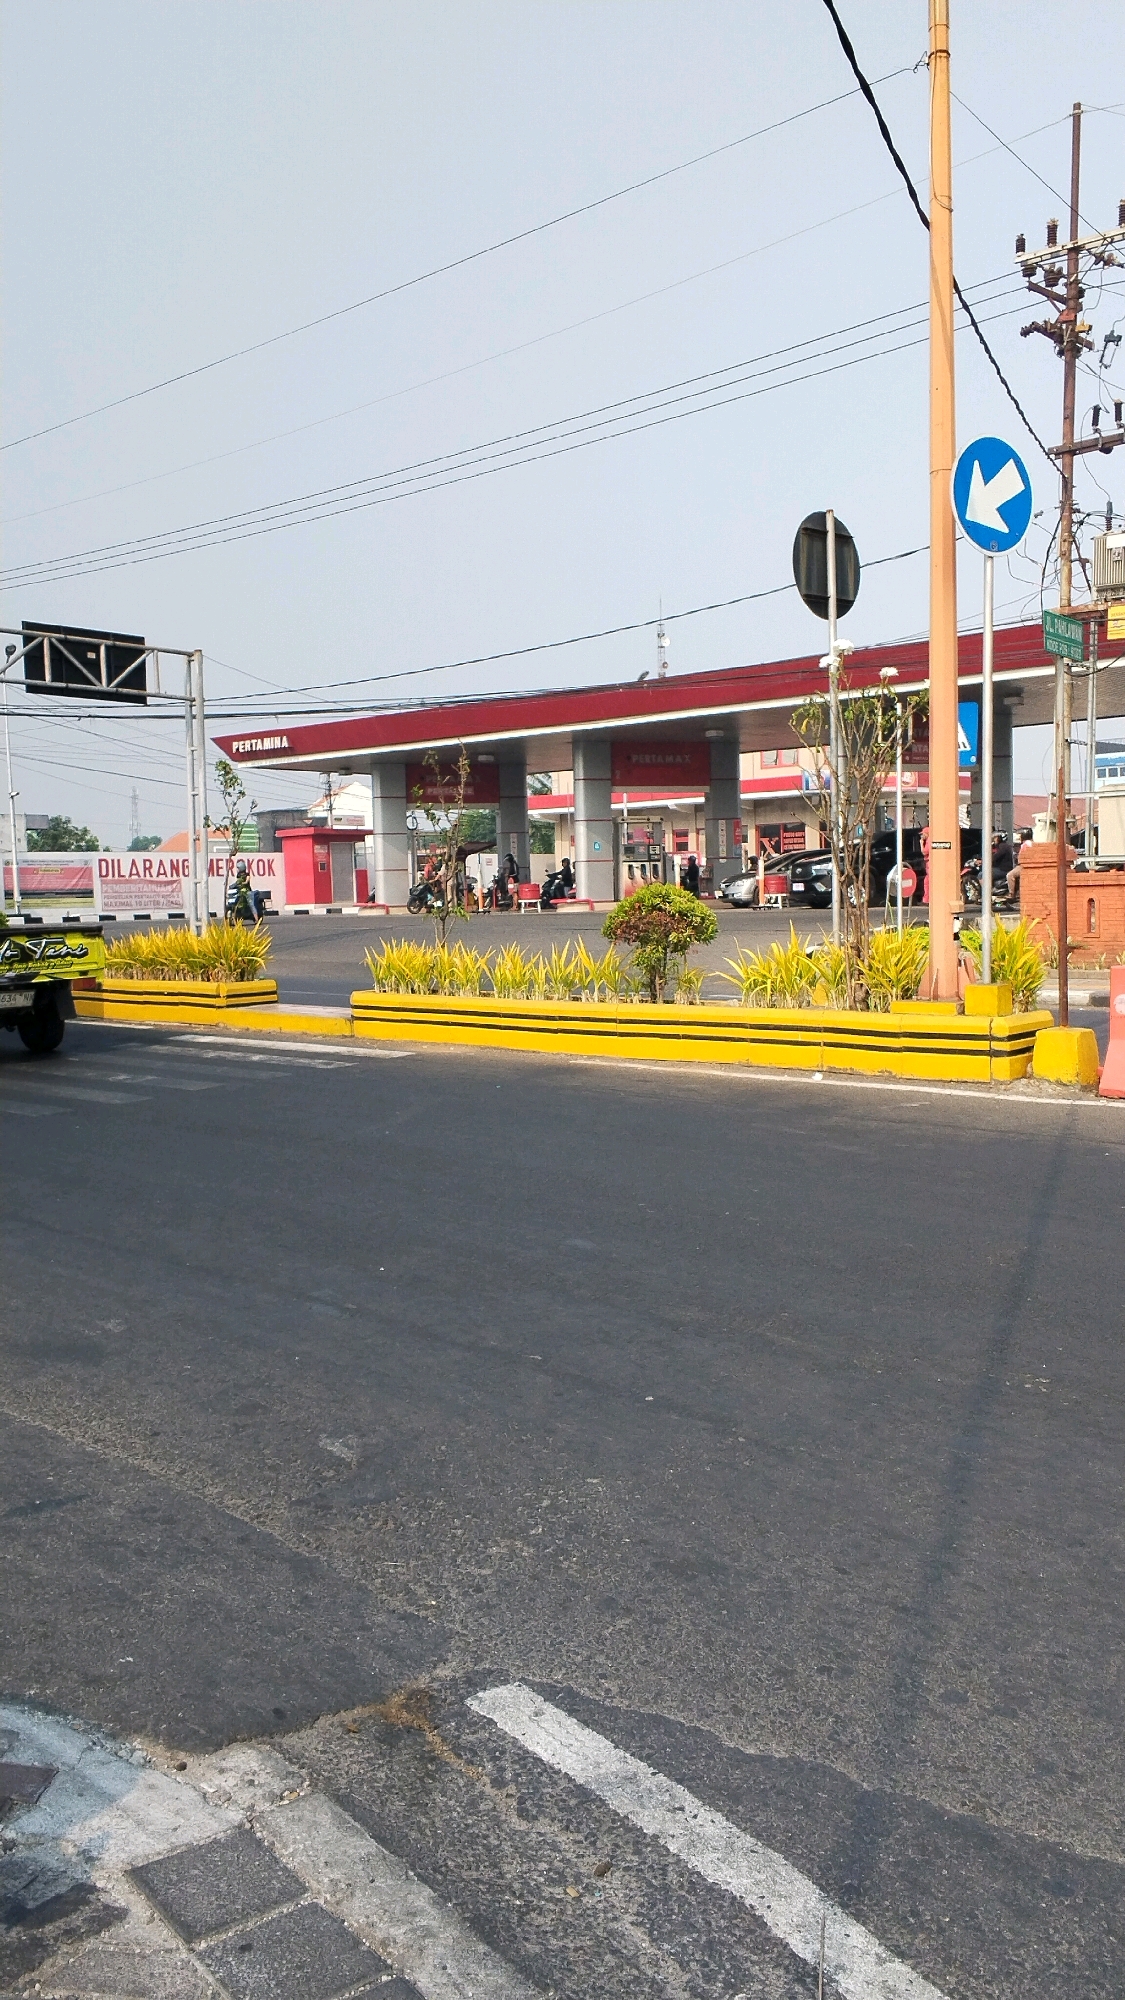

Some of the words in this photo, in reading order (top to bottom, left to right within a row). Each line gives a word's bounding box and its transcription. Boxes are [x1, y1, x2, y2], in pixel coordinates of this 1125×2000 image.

[232, 736, 288, 753] PERTAMINA
[630, 754, 691, 763] PERTAMAX
[98, 858, 189, 878] DILARANG
[26, 938, 88, 959] Tani
